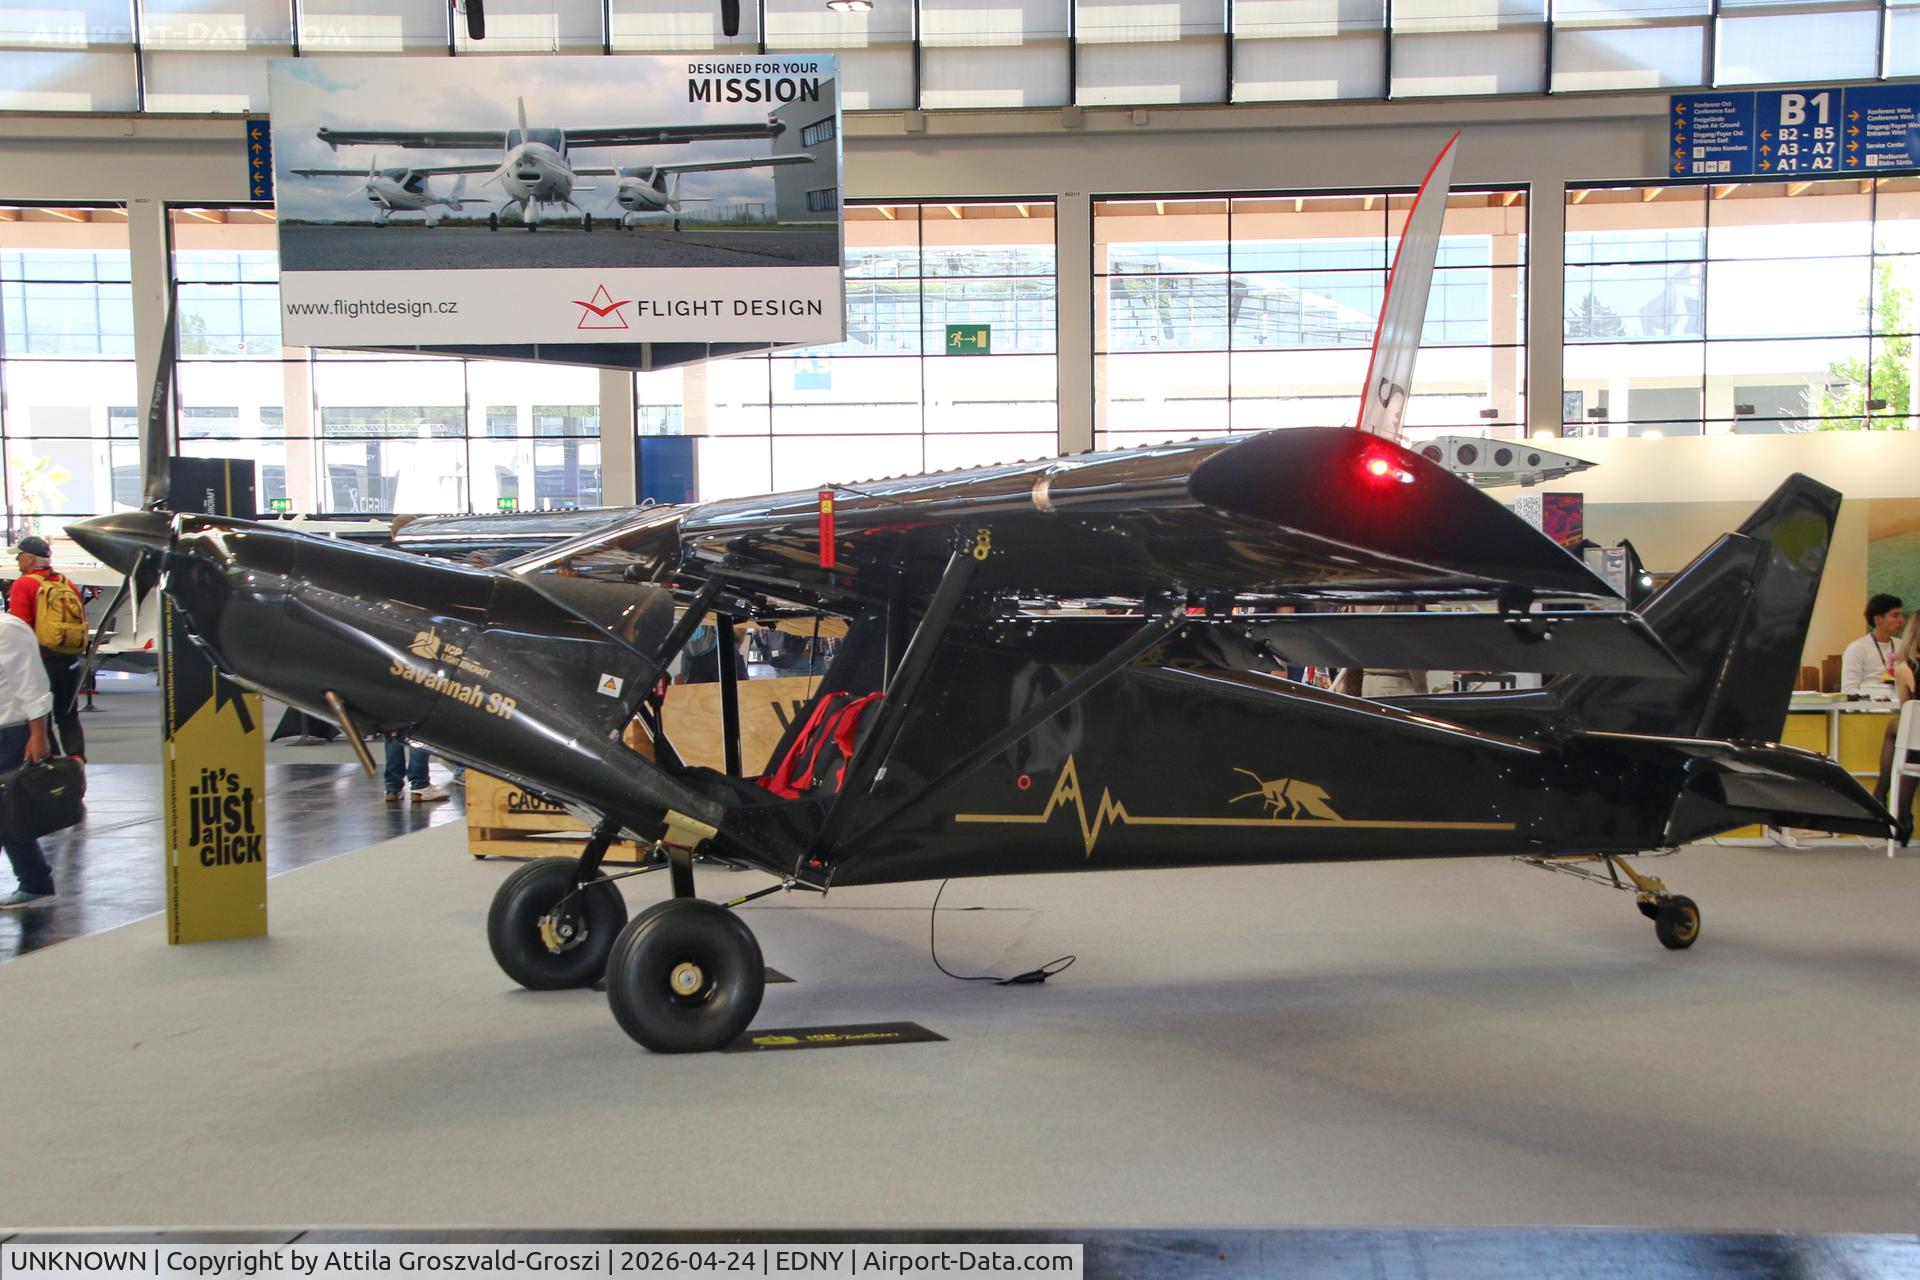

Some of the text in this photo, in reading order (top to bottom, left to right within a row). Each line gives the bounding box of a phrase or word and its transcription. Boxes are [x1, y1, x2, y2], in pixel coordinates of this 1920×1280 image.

[688, 62, 818, 74] DESIGNED FOR YOUR
[688, 78, 819, 103] MISSION
[1780, 92, 1829, 125] B1
[1779, 128, 1798, 141] B2
[1813, 126, 1834, 139] B5
[1777, 143, 1798, 156] A3
[1812, 142, 1835, 154] A7
[1776, 158, 1797, 171] A1
[1811, 156, 1833, 169] A2
[287, 299, 458, 318] www.flightdesign.cz
[638, 299, 823, 317] FLIGHT DESIGN
[443, 643, 463, 656] ICP
[390, 658, 517, 720] Savannah SR
[201, 768, 240, 794] it's
[202, 827, 214, 844] a
